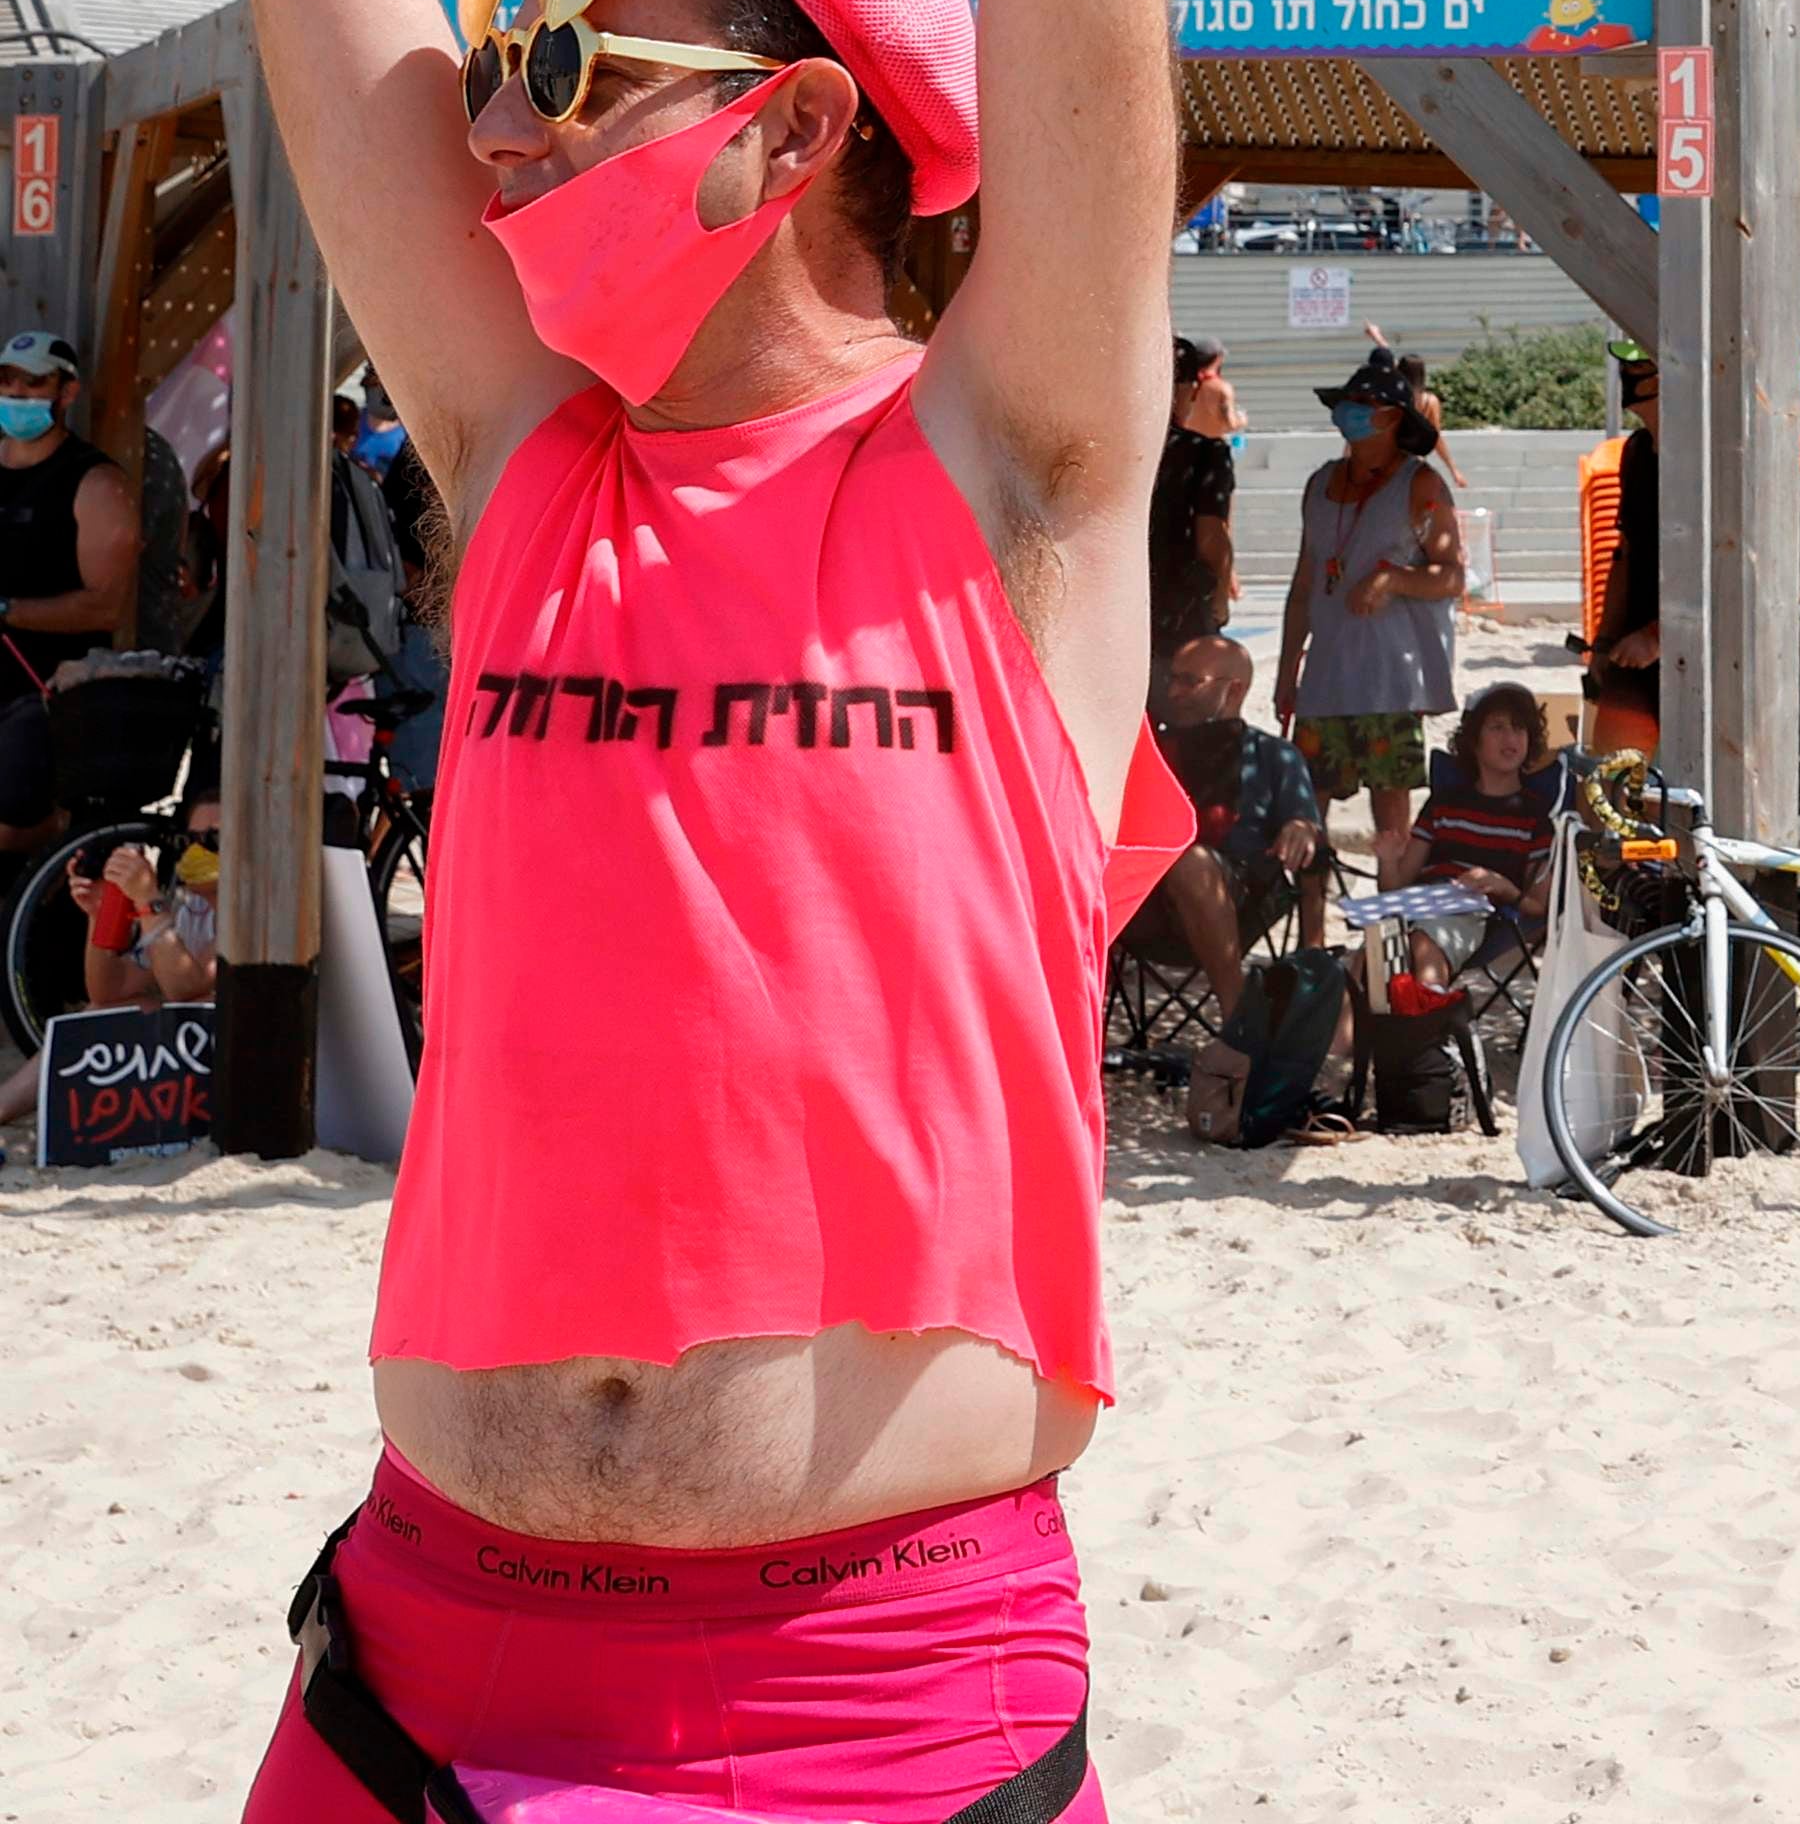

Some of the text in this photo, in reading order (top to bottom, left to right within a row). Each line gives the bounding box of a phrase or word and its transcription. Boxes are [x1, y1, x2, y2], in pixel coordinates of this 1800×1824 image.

[465, 670, 955, 754] החזית הורודה
[375, 1494, 423, 1546] Klein
[477, 1545, 670, 1594] Calvin Klein
[759, 1532, 982, 1589] Calvin Klein
